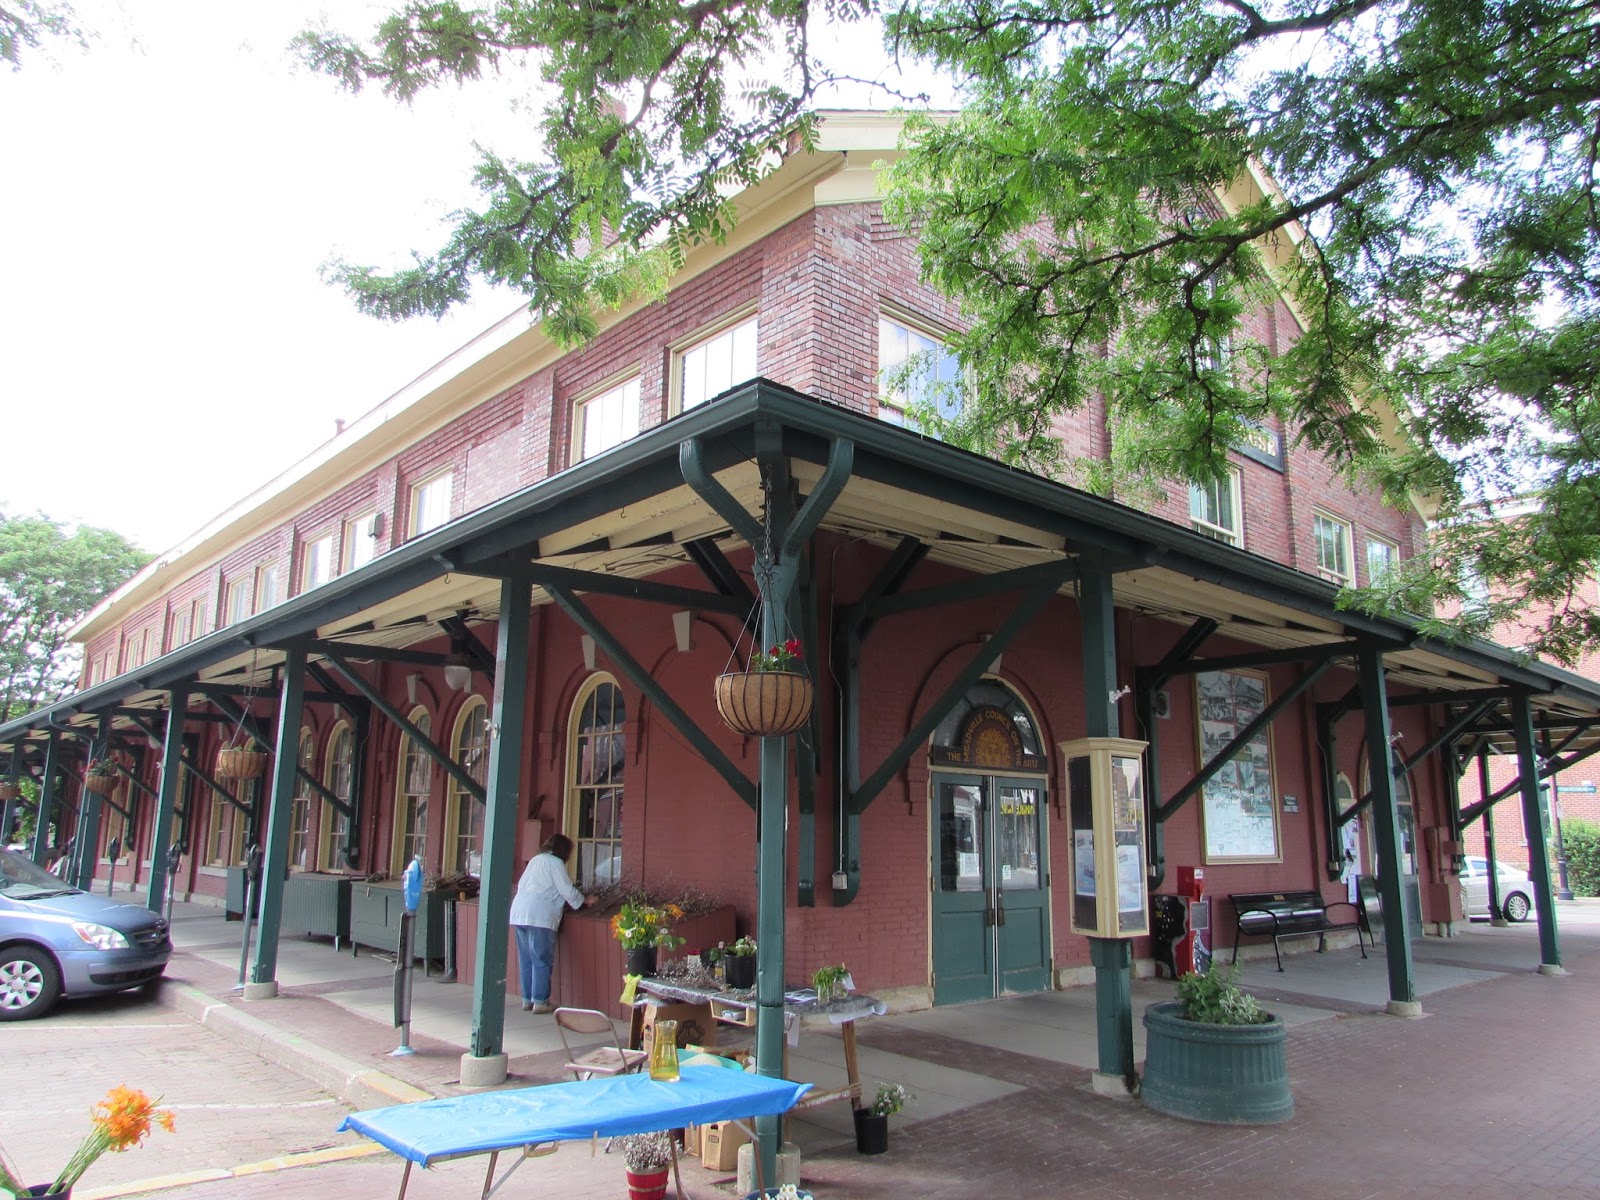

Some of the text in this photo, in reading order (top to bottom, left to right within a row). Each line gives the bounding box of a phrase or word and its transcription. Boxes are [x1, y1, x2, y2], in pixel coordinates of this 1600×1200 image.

[947, 752, 961, 762] THE
[963, 713, 983, 762] MEADVILLE
[985, 710, 1011, 730] COUNCIL
[1010, 731, 1019, 746] ON
[1023, 759, 1038, 768] ARTS
